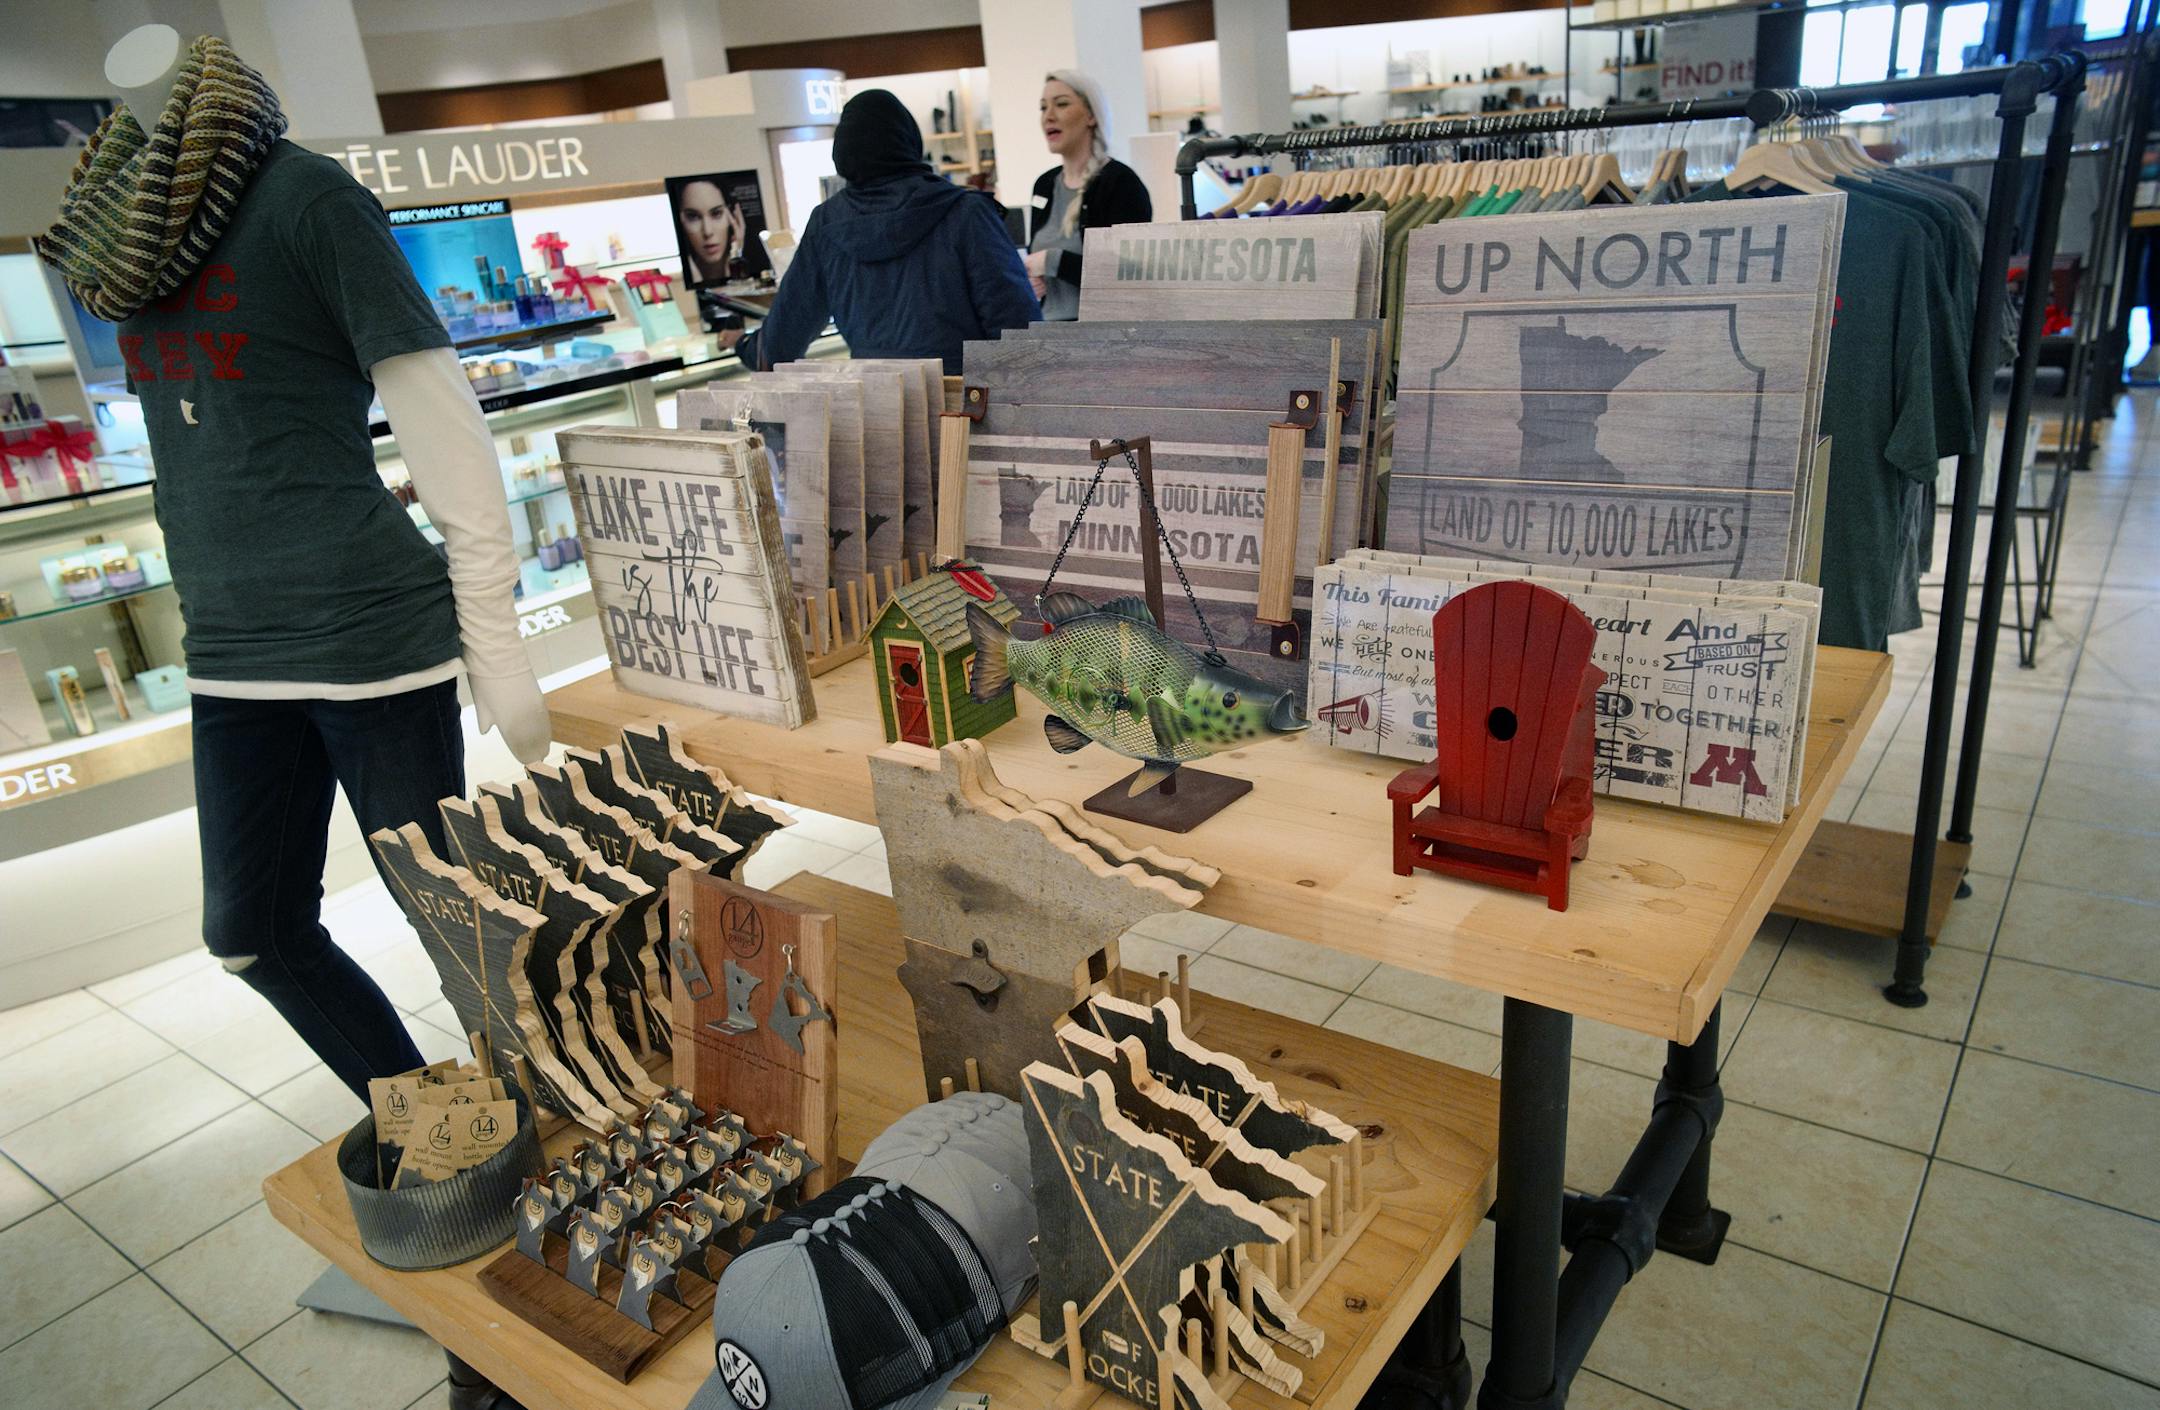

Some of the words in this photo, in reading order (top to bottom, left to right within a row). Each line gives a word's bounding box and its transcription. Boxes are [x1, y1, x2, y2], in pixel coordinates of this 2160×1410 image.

[1662, 60, 1723, 88] FIND
[416, 137, 588, 190] LAUDER
[1117, 237, 1317, 282] MINNESOTA
[1435, 241, 1511, 296] UP
[1535, 224, 1788, 292] NORTH
[579, 474, 659, 546] LAKE
[659, 480, 734, 556] LIFE
[1055, 476, 1104, 508] LAND
[1108, 479, 1132, 509] OF
[1202, 484, 1266, 519] LAKES
[1058, 520, 1261, 566] MINNSOTA
[1429, 493, 1493, 544] LAND
[1502, 499, 1537, 550] OF
[1547, 501, 1637, 565] 10,000
[1646, 505, 1734, 557] LAKES
[622, 560, 653, 619] is
[641, 528, 724, 636] the
[1322, 582, 1370, 604] This
[1587, 616, 1652, 636] eart
[1664, 618, 1738, 642] And
[607, 604, 687, 680] BEST
[691, 619, 765, 696] LIFE
[1321, 636, 1345, 650] WE
[1356, 640, 1393, 656] HELP
[1707, 685, 1784, 709] OTHER
[1698, 644, 1733, 659] BASED
[1736, 643, 1751, 656] ON
[1706, 661, 1775, 681] TRUST
[1352, 665, 1374, 677] But
[1375, 671, 1404, 682] most
[1406, 673, 1420, 688] of
[1640, 701, 1783, 740] TOGETHER
[417, 889, 475, 929] STATE
[477, 861, 536, 906] STATE
[1148, 1069, 1232, 1121] TATE
[1073, 1145, 1163, 1210] STATE
[1087, 1353, 1158, 1406] OCKE
